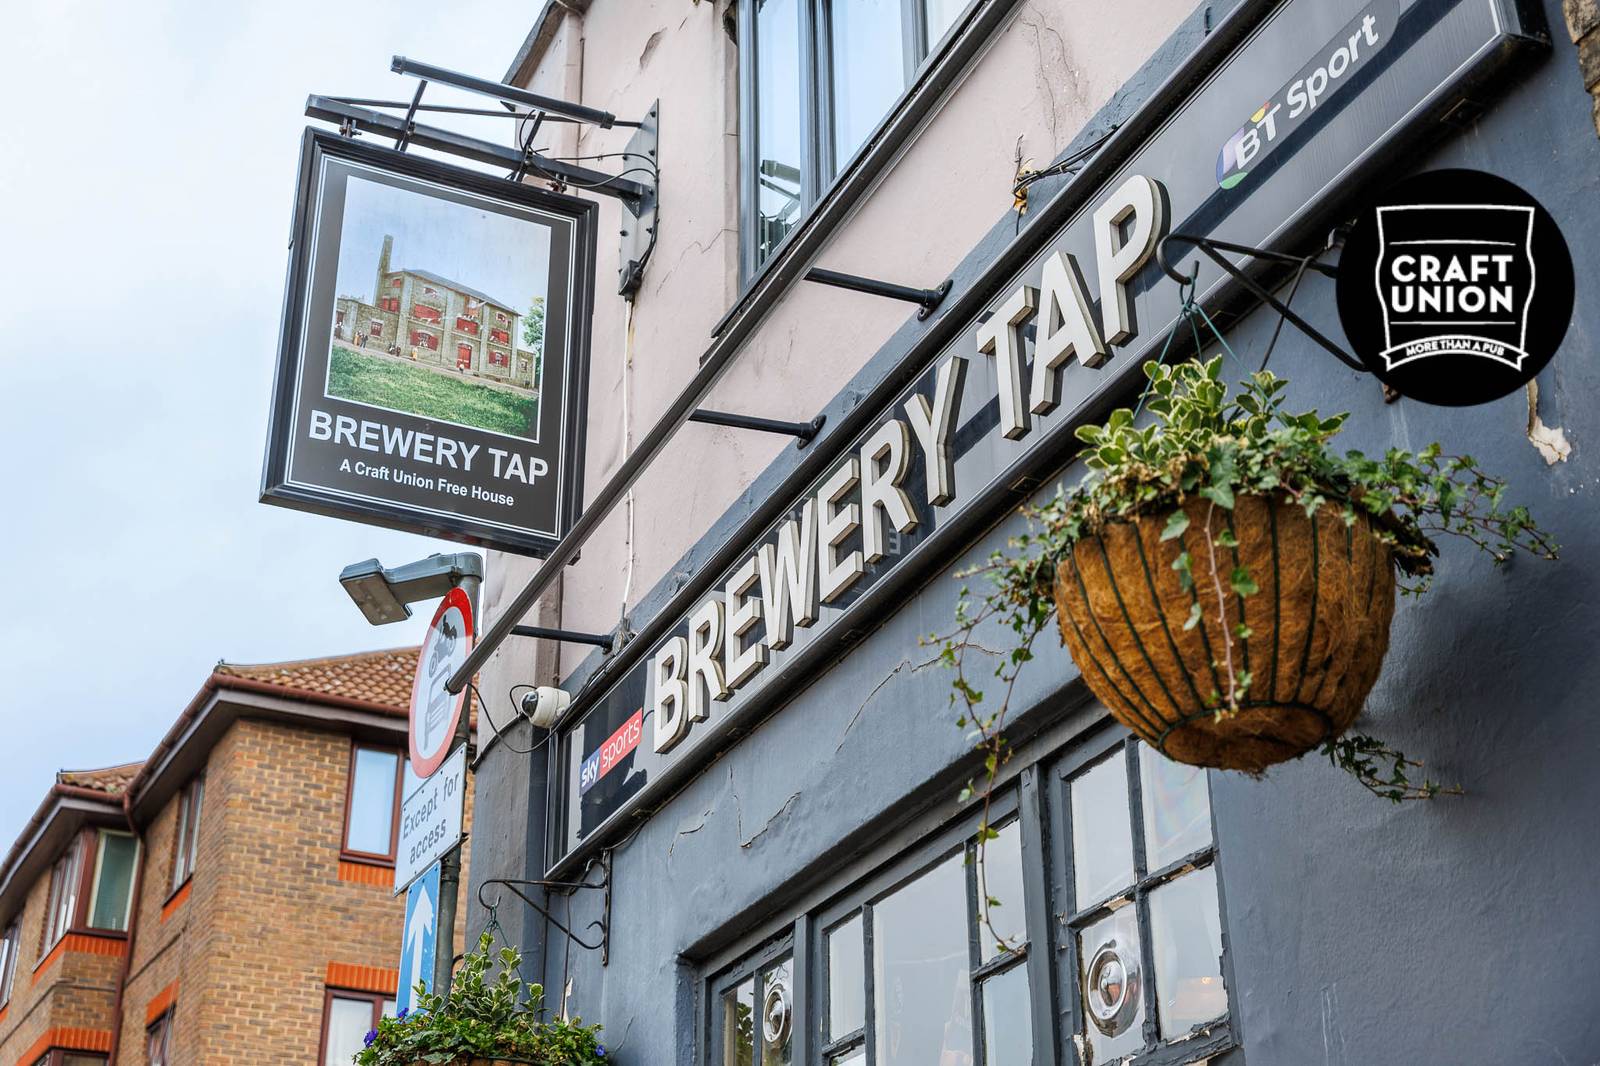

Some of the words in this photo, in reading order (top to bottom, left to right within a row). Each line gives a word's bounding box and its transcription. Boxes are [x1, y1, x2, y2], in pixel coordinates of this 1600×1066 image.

[1234, 102, 1282, 170] BT
[308, 409, 480, 472] BREWERY
[488, 447, 549, 486] TAP
[653, 356, 969, 754] BREWERY
[977, 174, 1170, 441] TAP
[339, 459, 351, 473] A
[354, 461, 390, 481] Craft
[393, 469, 434, 491] Union
[437, 479, 468, 497] Free
[471, 485, 514, 506] House
[581, 756, 600, 788] sky
[602, 719, 640, 769] sports
[403, 787, 438, 840] Except
[443, 772, 460, 802] for
[409, 818, 447, 865] access
